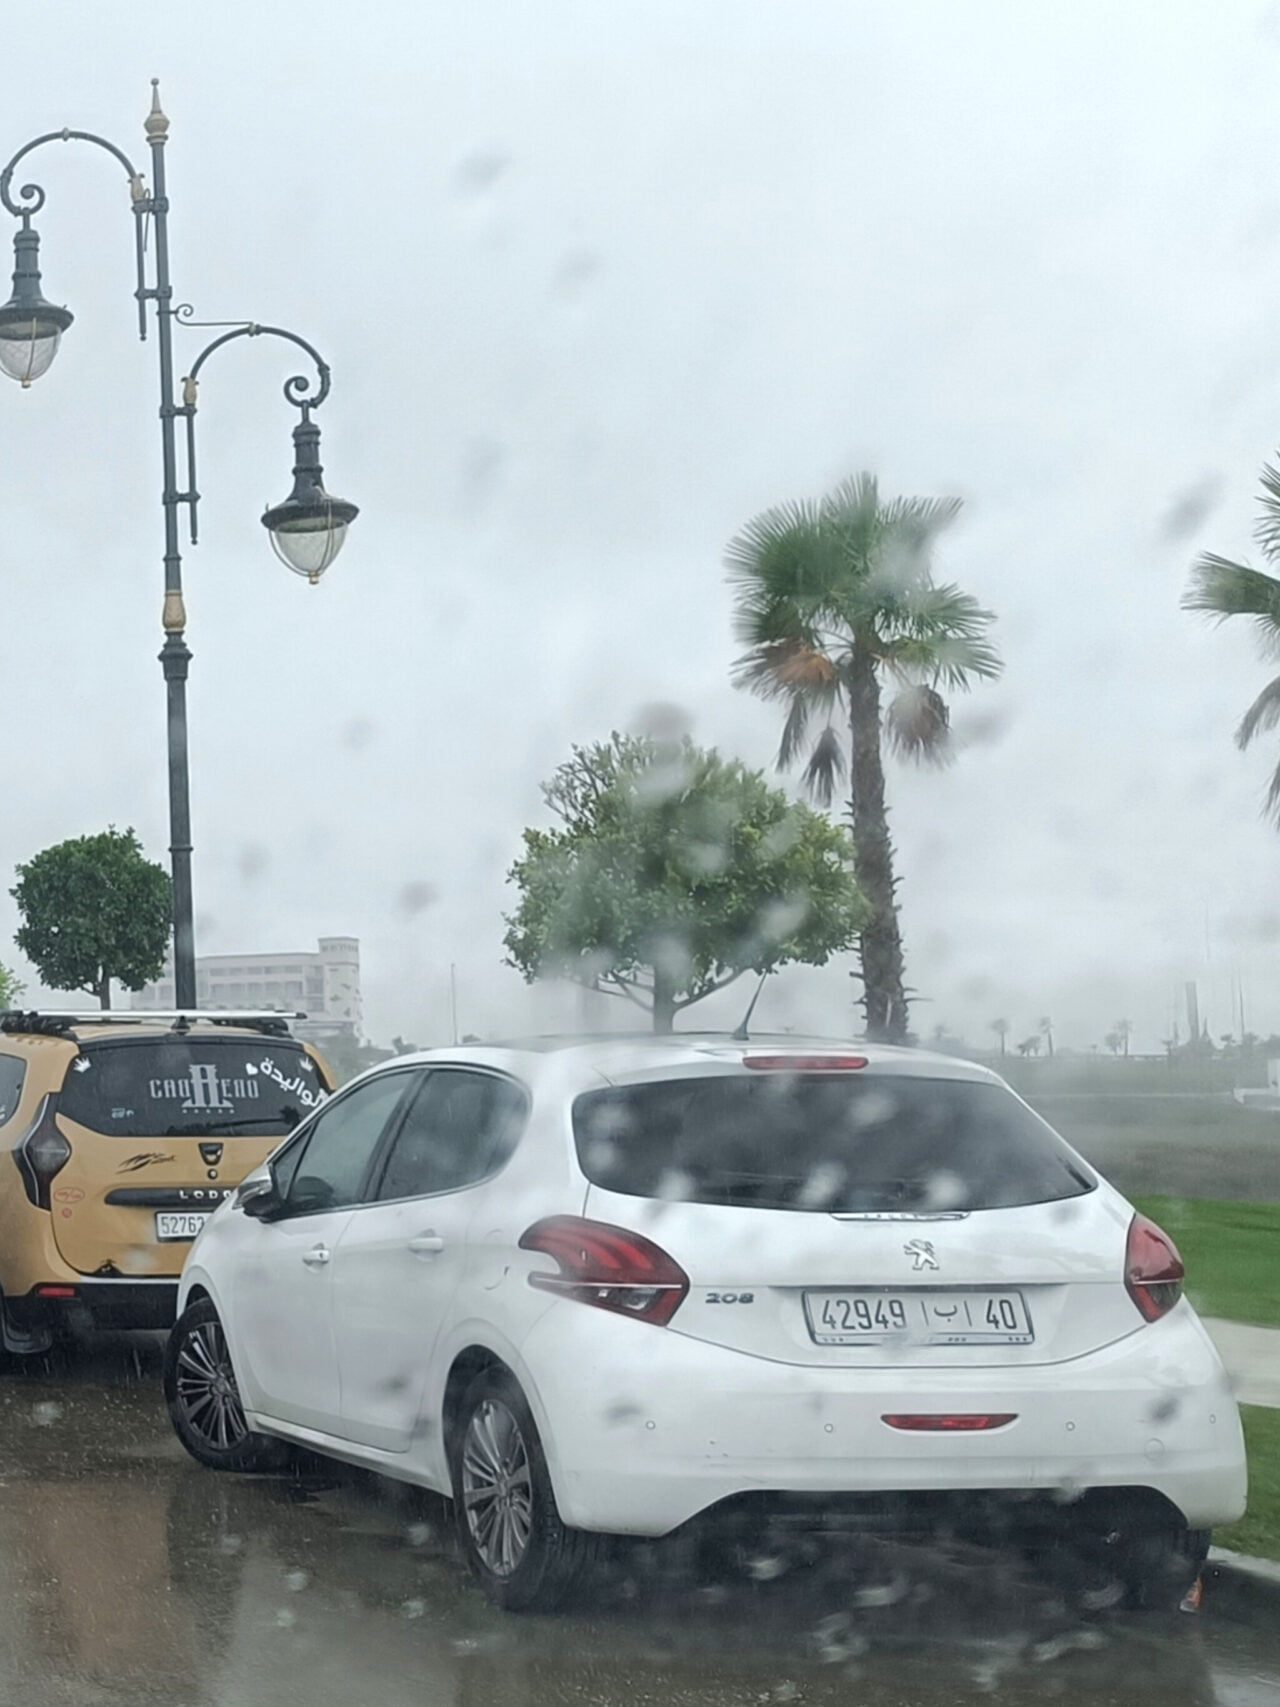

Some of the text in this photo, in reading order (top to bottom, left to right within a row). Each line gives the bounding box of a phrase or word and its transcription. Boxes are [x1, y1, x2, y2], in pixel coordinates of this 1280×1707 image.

[179, 1189, 232, 1199] LODG
[705, 1292, 754, 1304] 208
[822, 1299, 906, 1330] 42949
[985, 1299, 1017, 1330] 40
